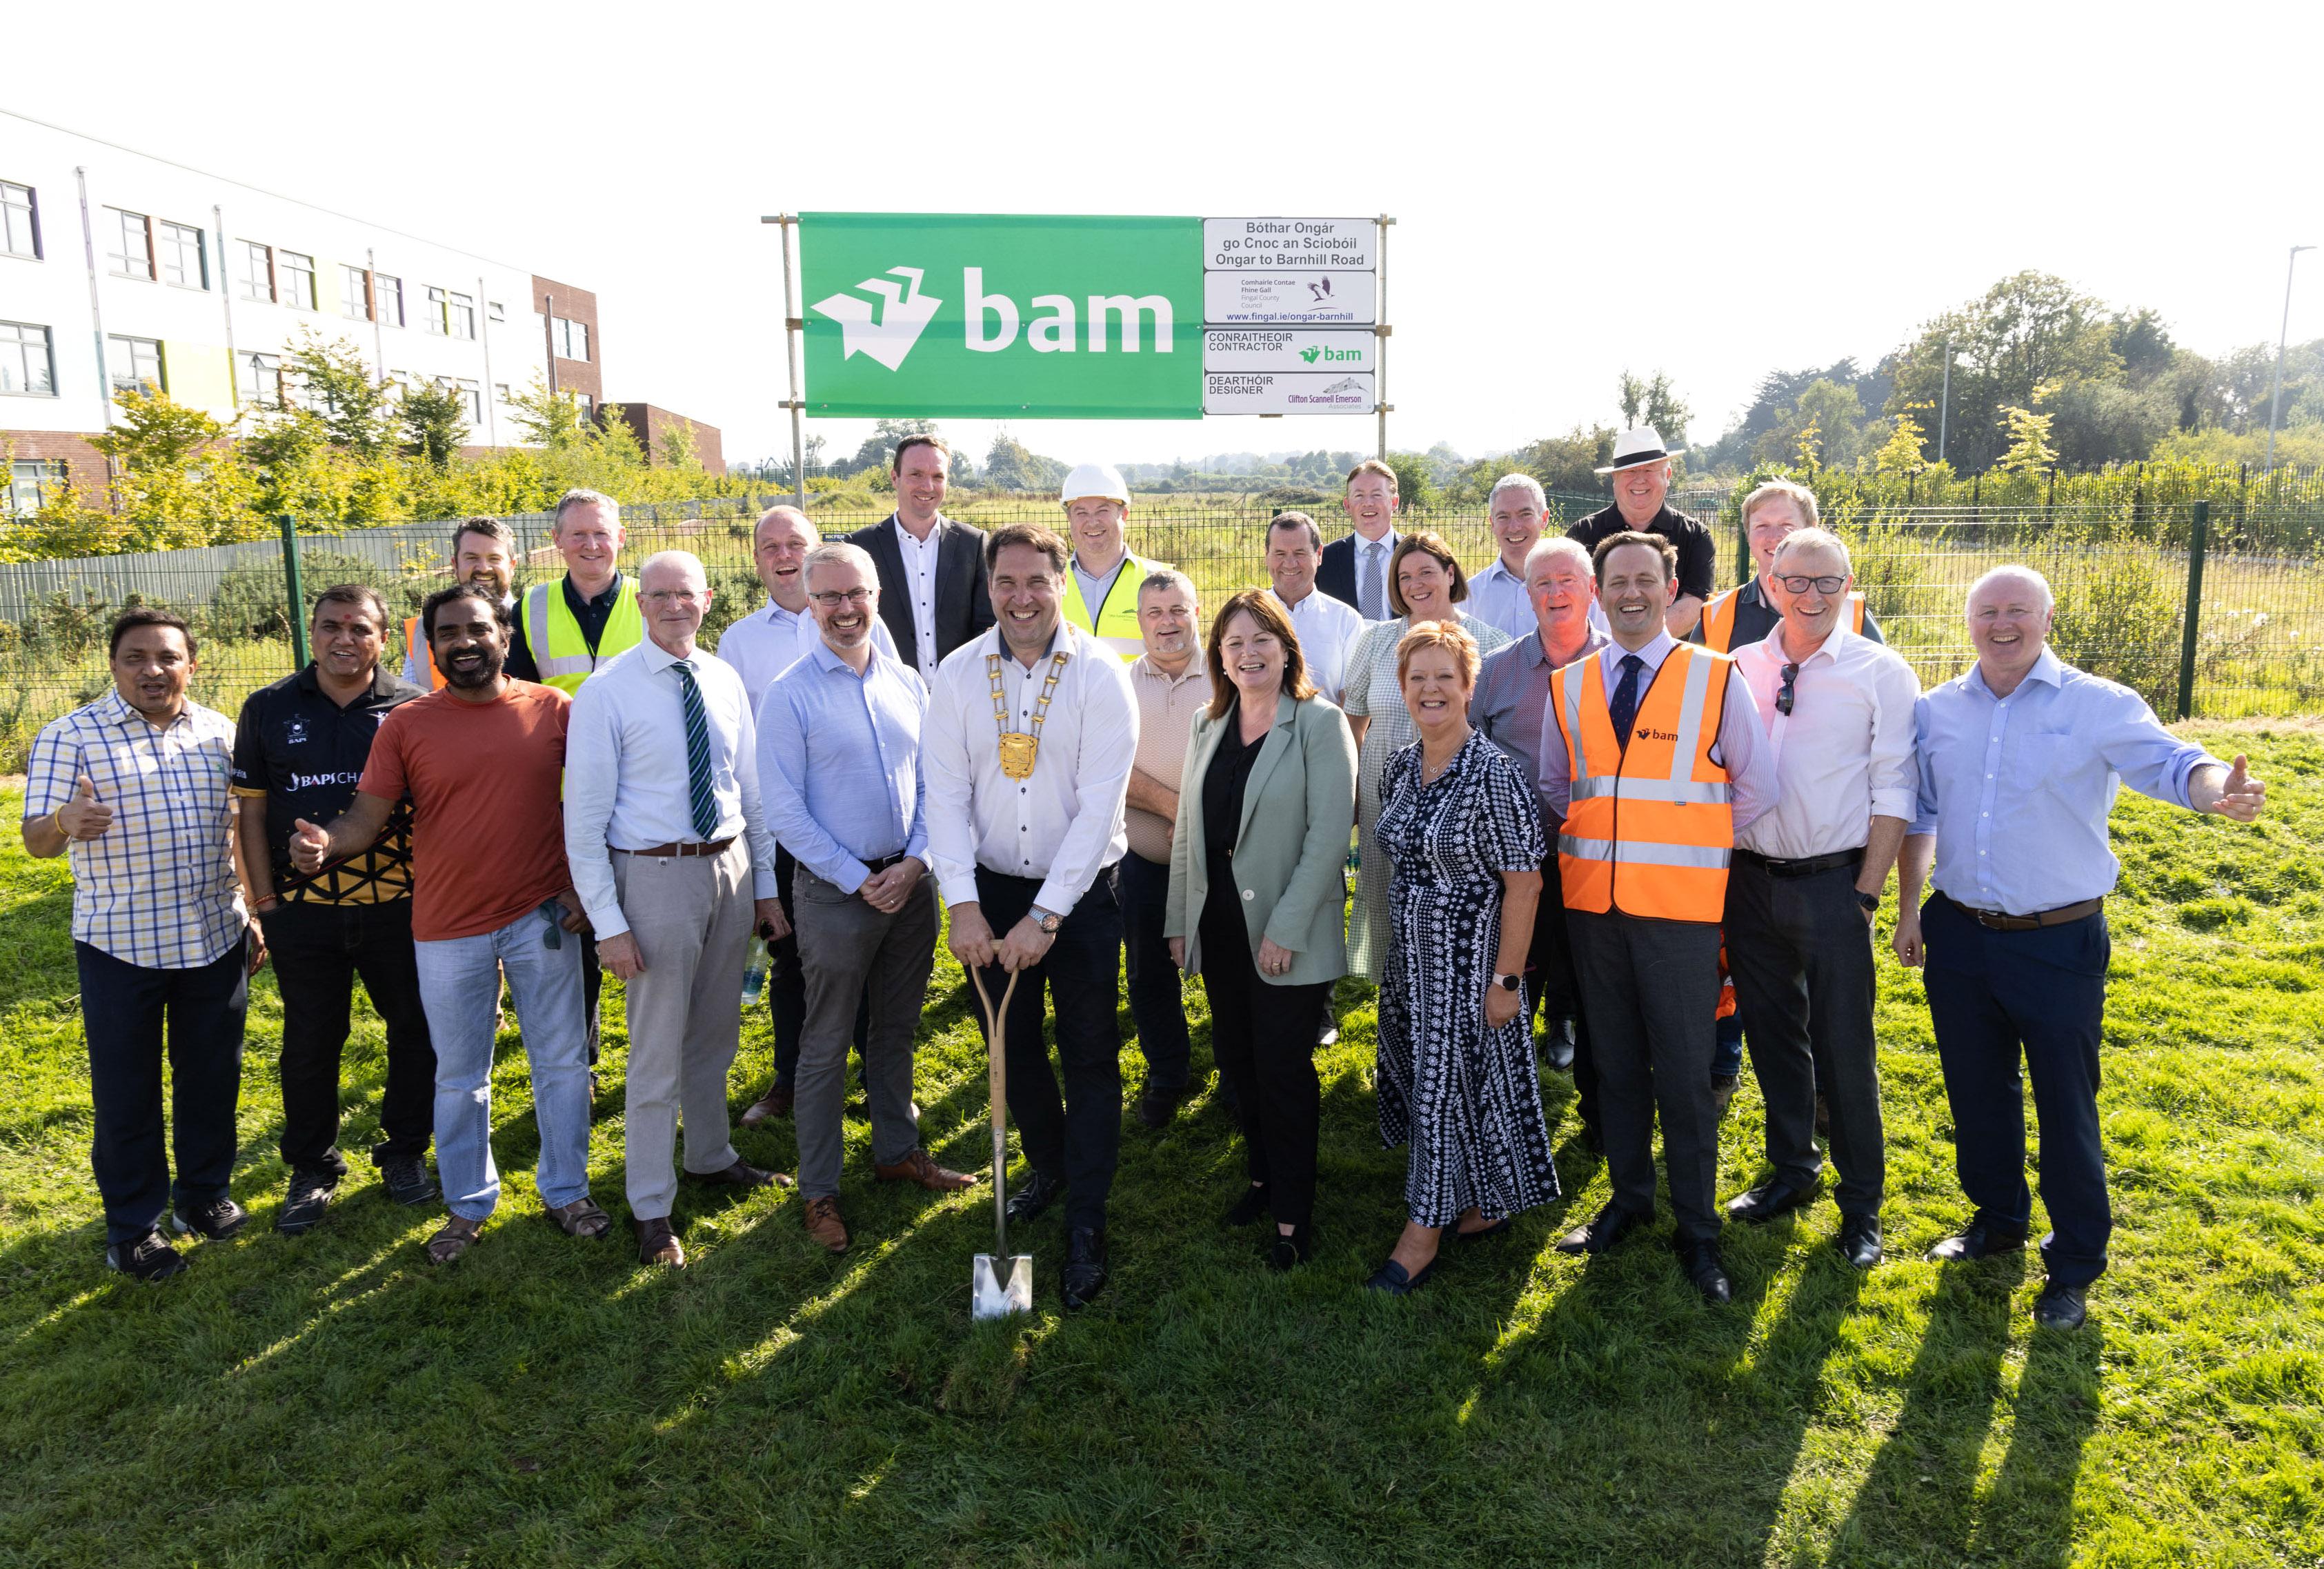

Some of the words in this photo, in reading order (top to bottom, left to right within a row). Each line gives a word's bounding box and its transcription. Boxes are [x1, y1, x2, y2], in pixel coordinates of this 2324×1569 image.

[1247, 222, 1291, 232] Bóthar
[1295, 222, 1334, 236] Ongár
[1224, 240, 1240, 251] go
[1244, 237, 1278, 248] Cnoc
[1283, 240, 1298, 248] an
[1304, 237, 1356, 248] Sciobóil
[1216, 254, 1255, 267] Ongar
[1260, 254, 1272, 264] to
[1278, 254, 1326, 265] Barnhill
[1331, 254, 1364, 265] Road
[1260, 294, 1280, 303] County
[964, 267, 1173, 353] bam
[1226, 312, 1353, 323] www.fingal.ie/ongar-barnhill
[1209, 333, 1292, 341] CONRAITHEOIR
[1209, 343, 1282, 351] CONTRACTOR
[1324, 346, 1361, 361] bam
[1210, 374, 1273, 385] DEARTHÓIR
[1289, 394, 1307, 403] Clifton
[1309, 394, 1333, 403] Scannell
[1653, 728, 1678, 741] bam
